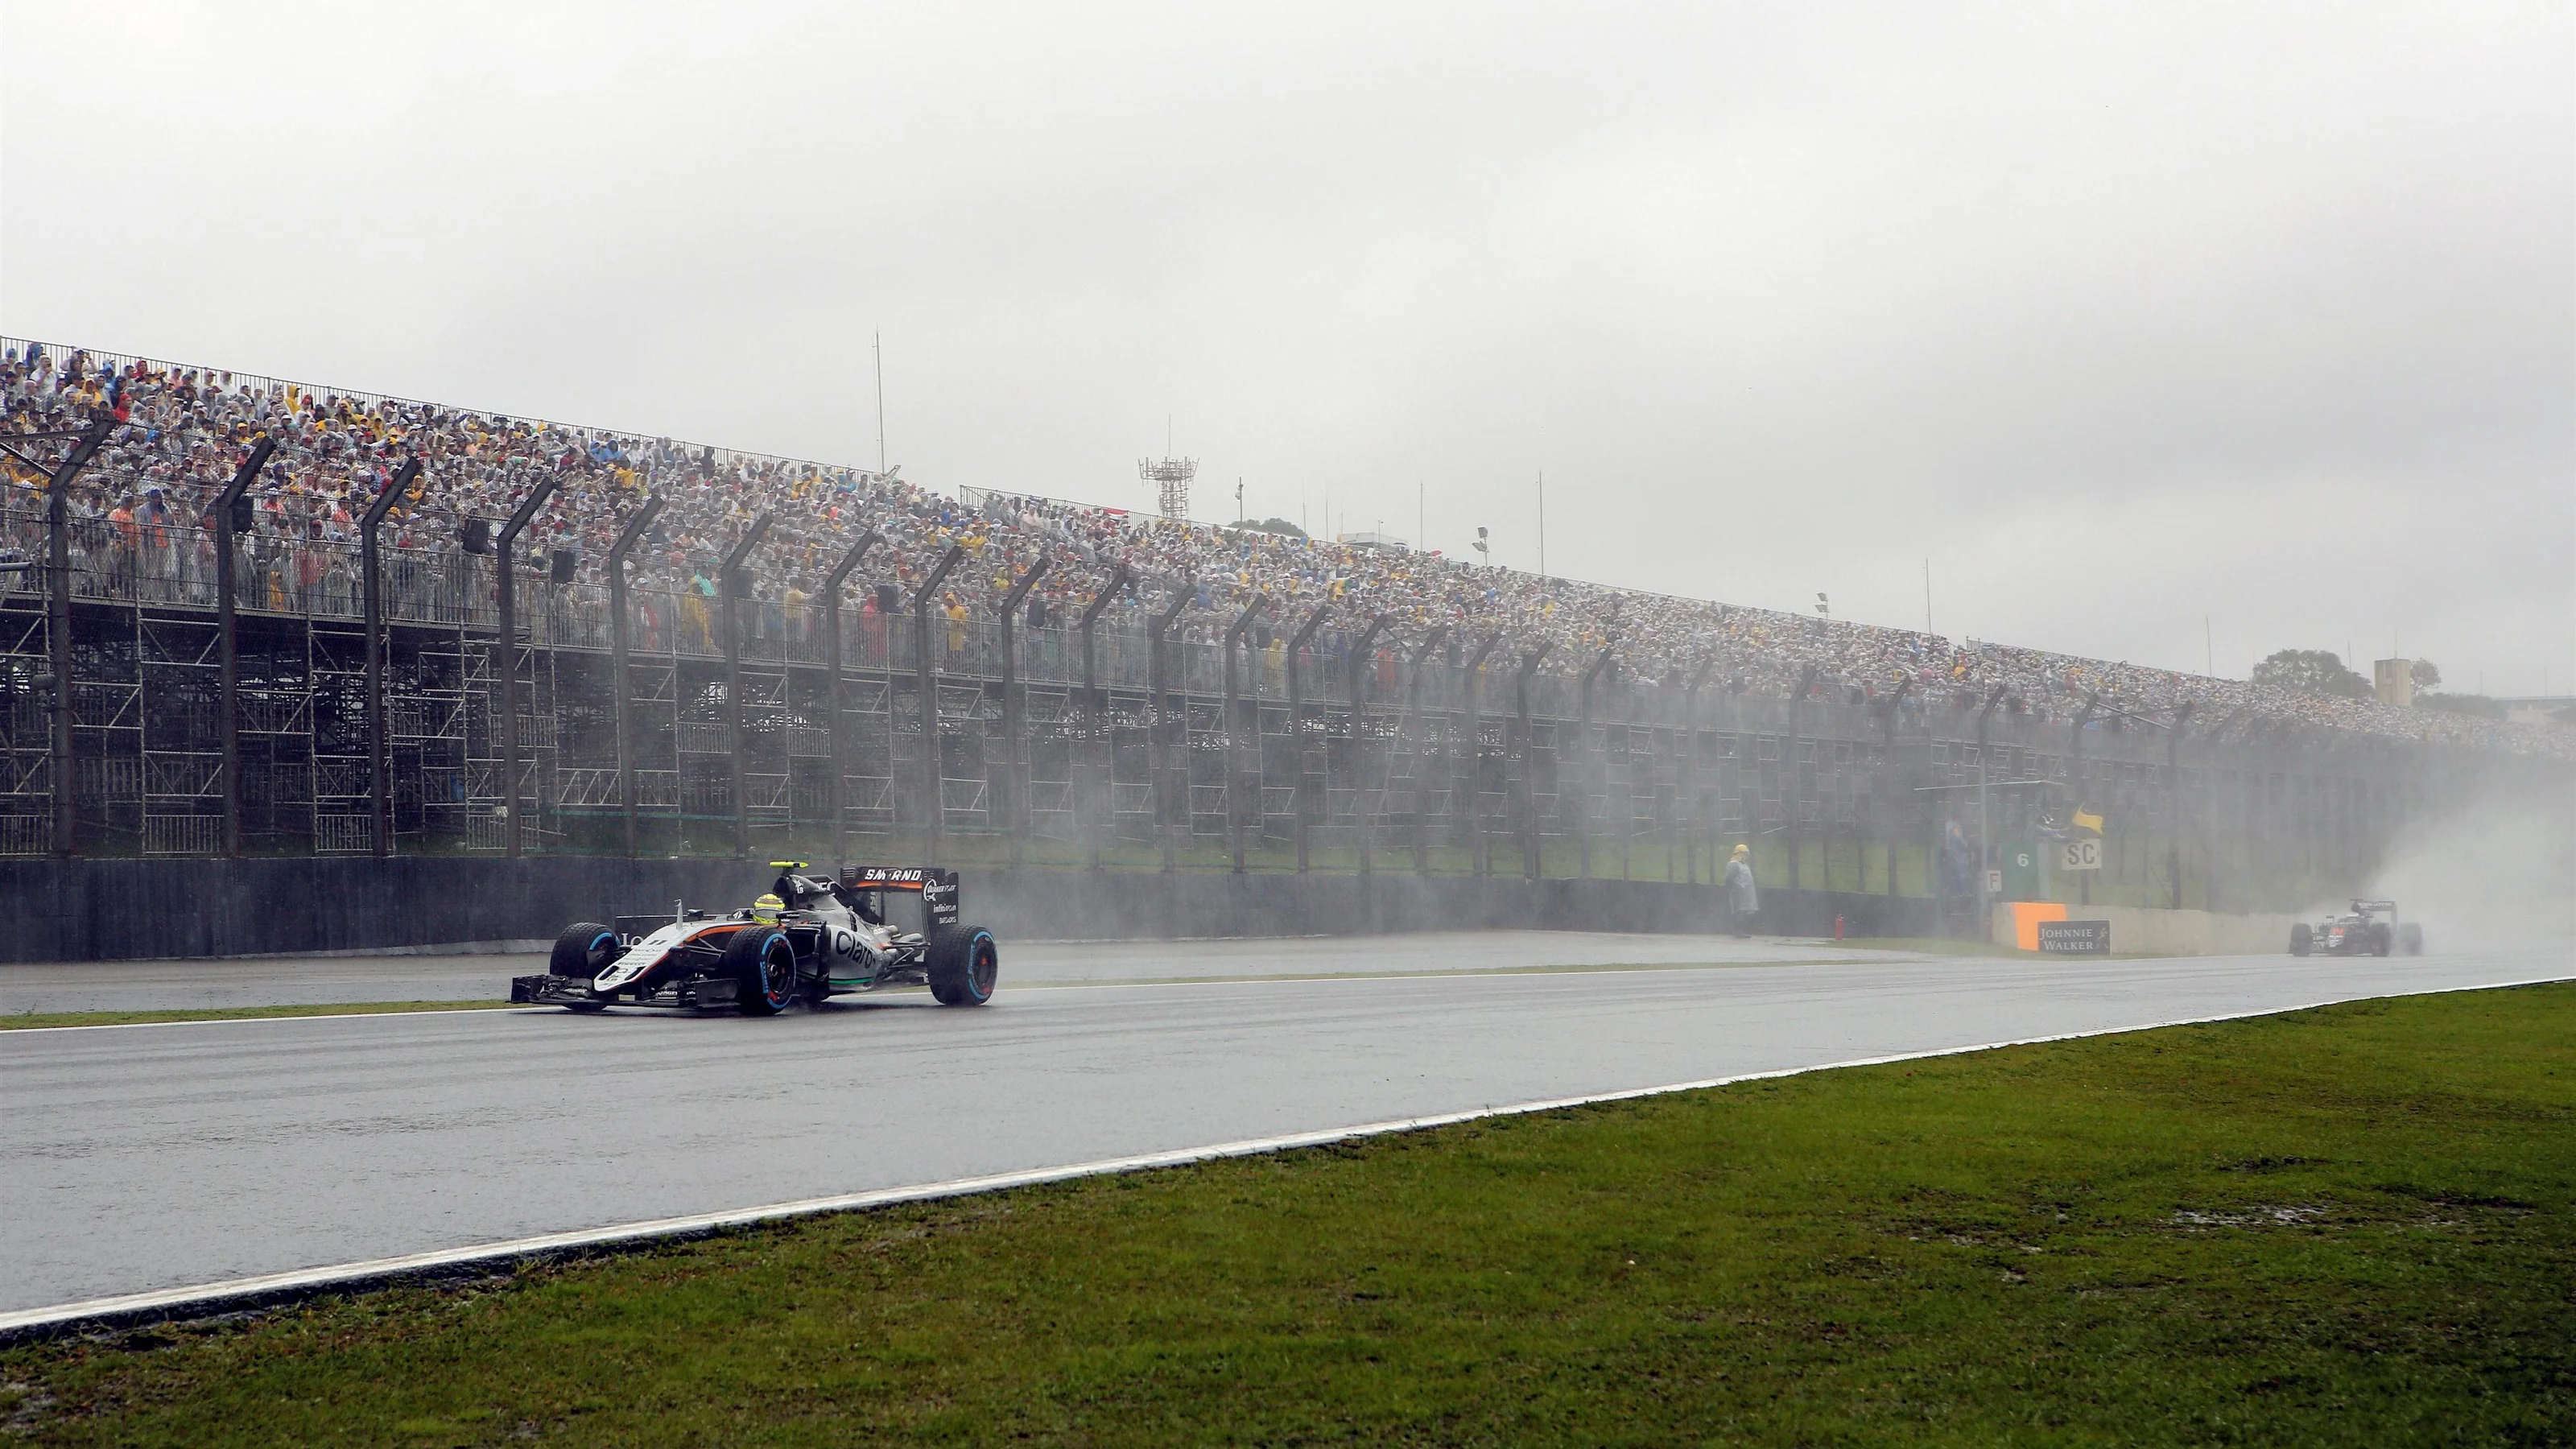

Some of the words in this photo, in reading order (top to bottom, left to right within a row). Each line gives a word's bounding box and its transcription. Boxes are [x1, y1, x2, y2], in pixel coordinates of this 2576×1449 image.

[2017, 853, 2029, 867] 6
[2067, 844, 2095, 865] SC
[1989, 873, 1999, 889] F
[2040, 928, 2093, 939] JOHNNIE
[836, 931, 873, 969] Claro
[2045, 941, 2093, 950] WALKER
